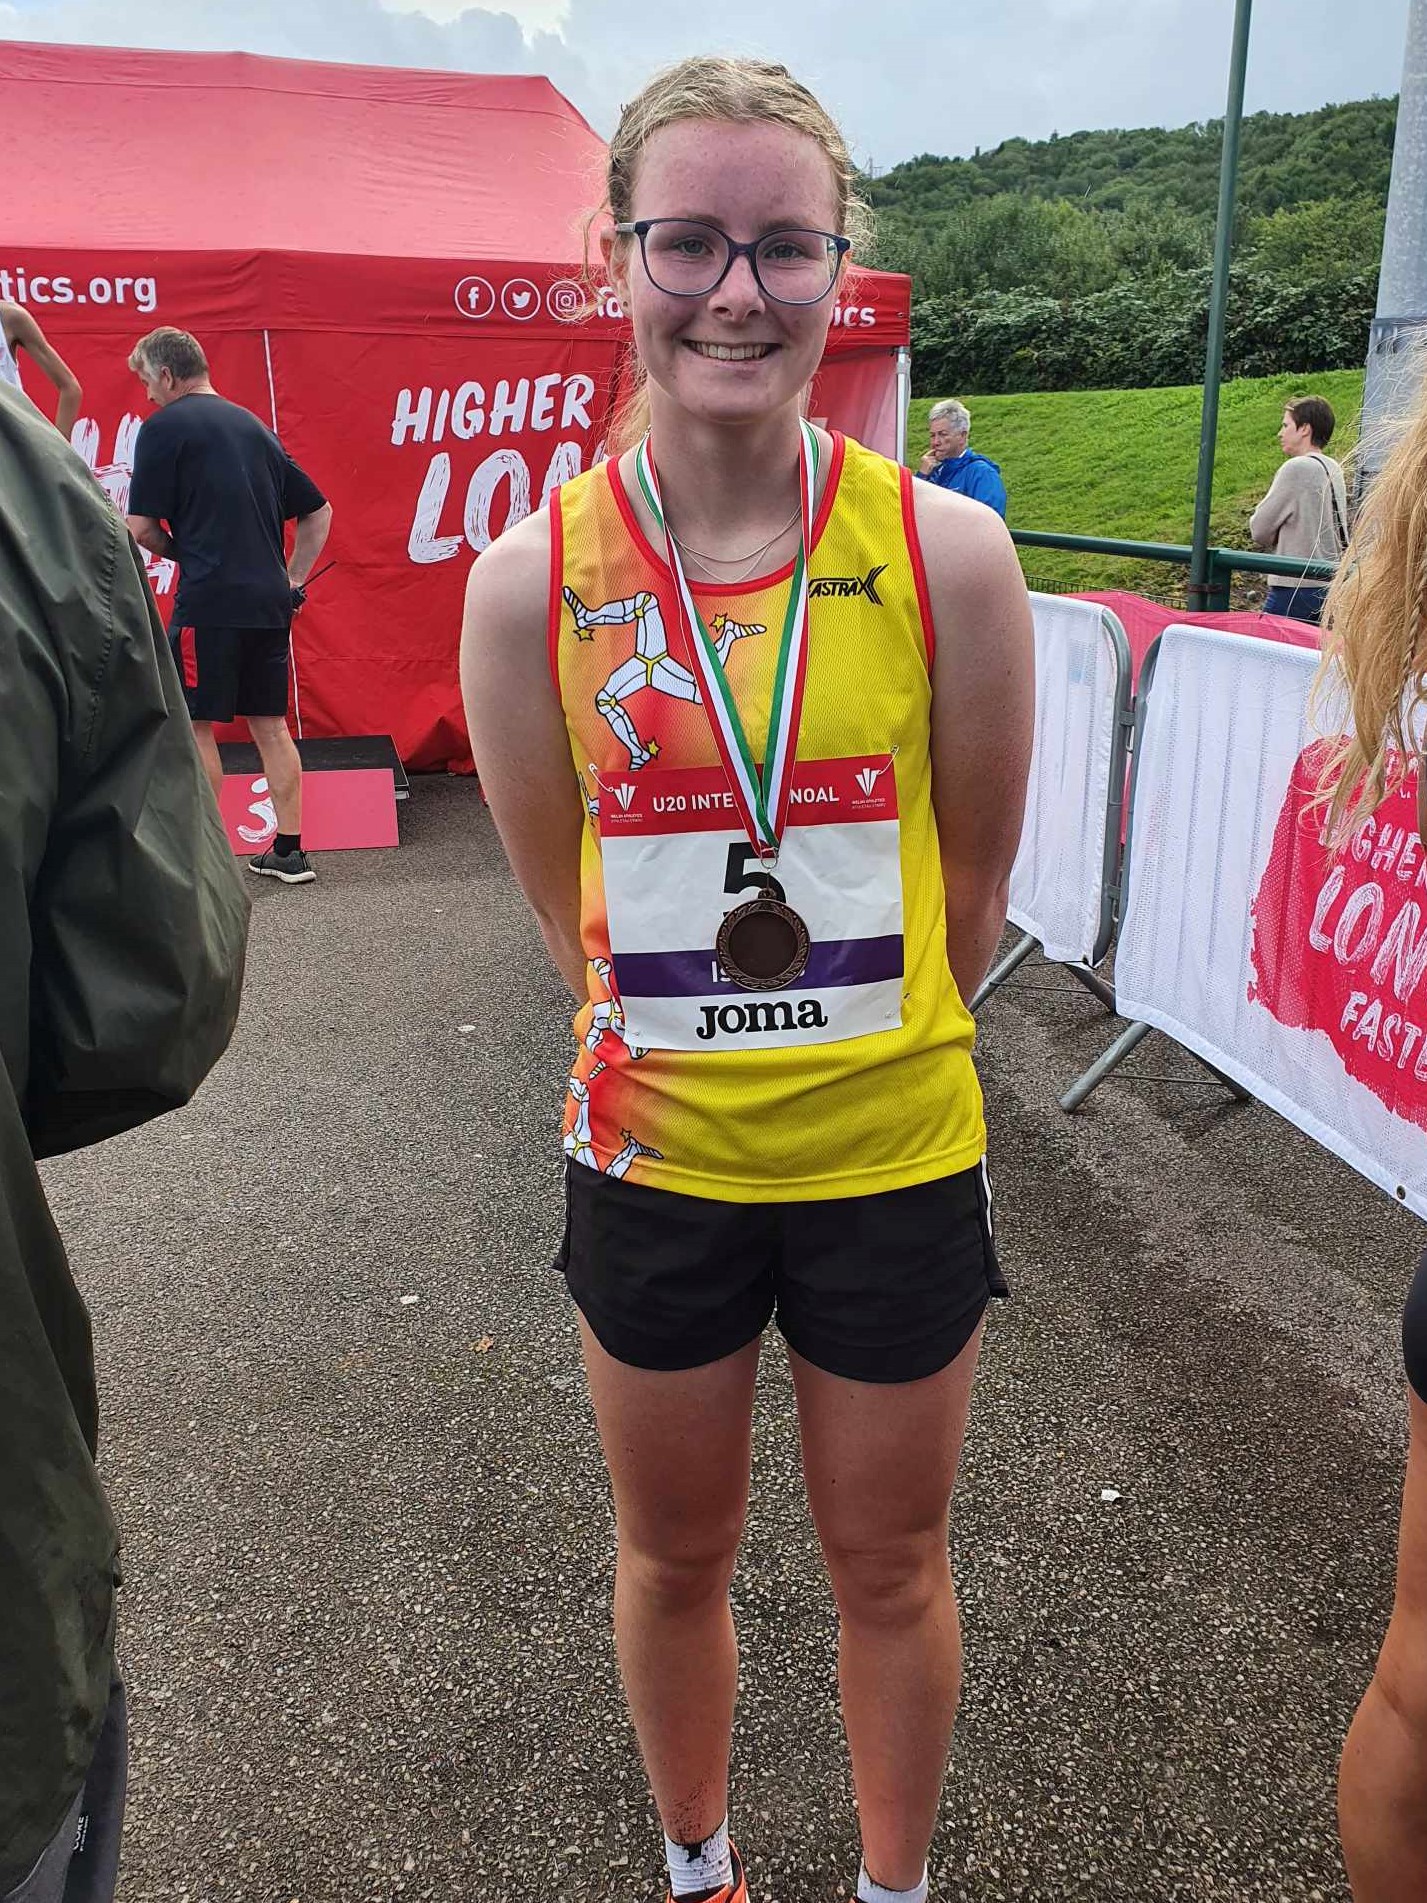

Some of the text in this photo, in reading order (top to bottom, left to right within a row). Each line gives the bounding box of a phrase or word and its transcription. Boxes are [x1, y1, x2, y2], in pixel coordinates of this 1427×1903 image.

[391, 373, 596, 446] HIGHER
[653, 796, 687, 812] U20
[723, 842, 787, 917] 5
